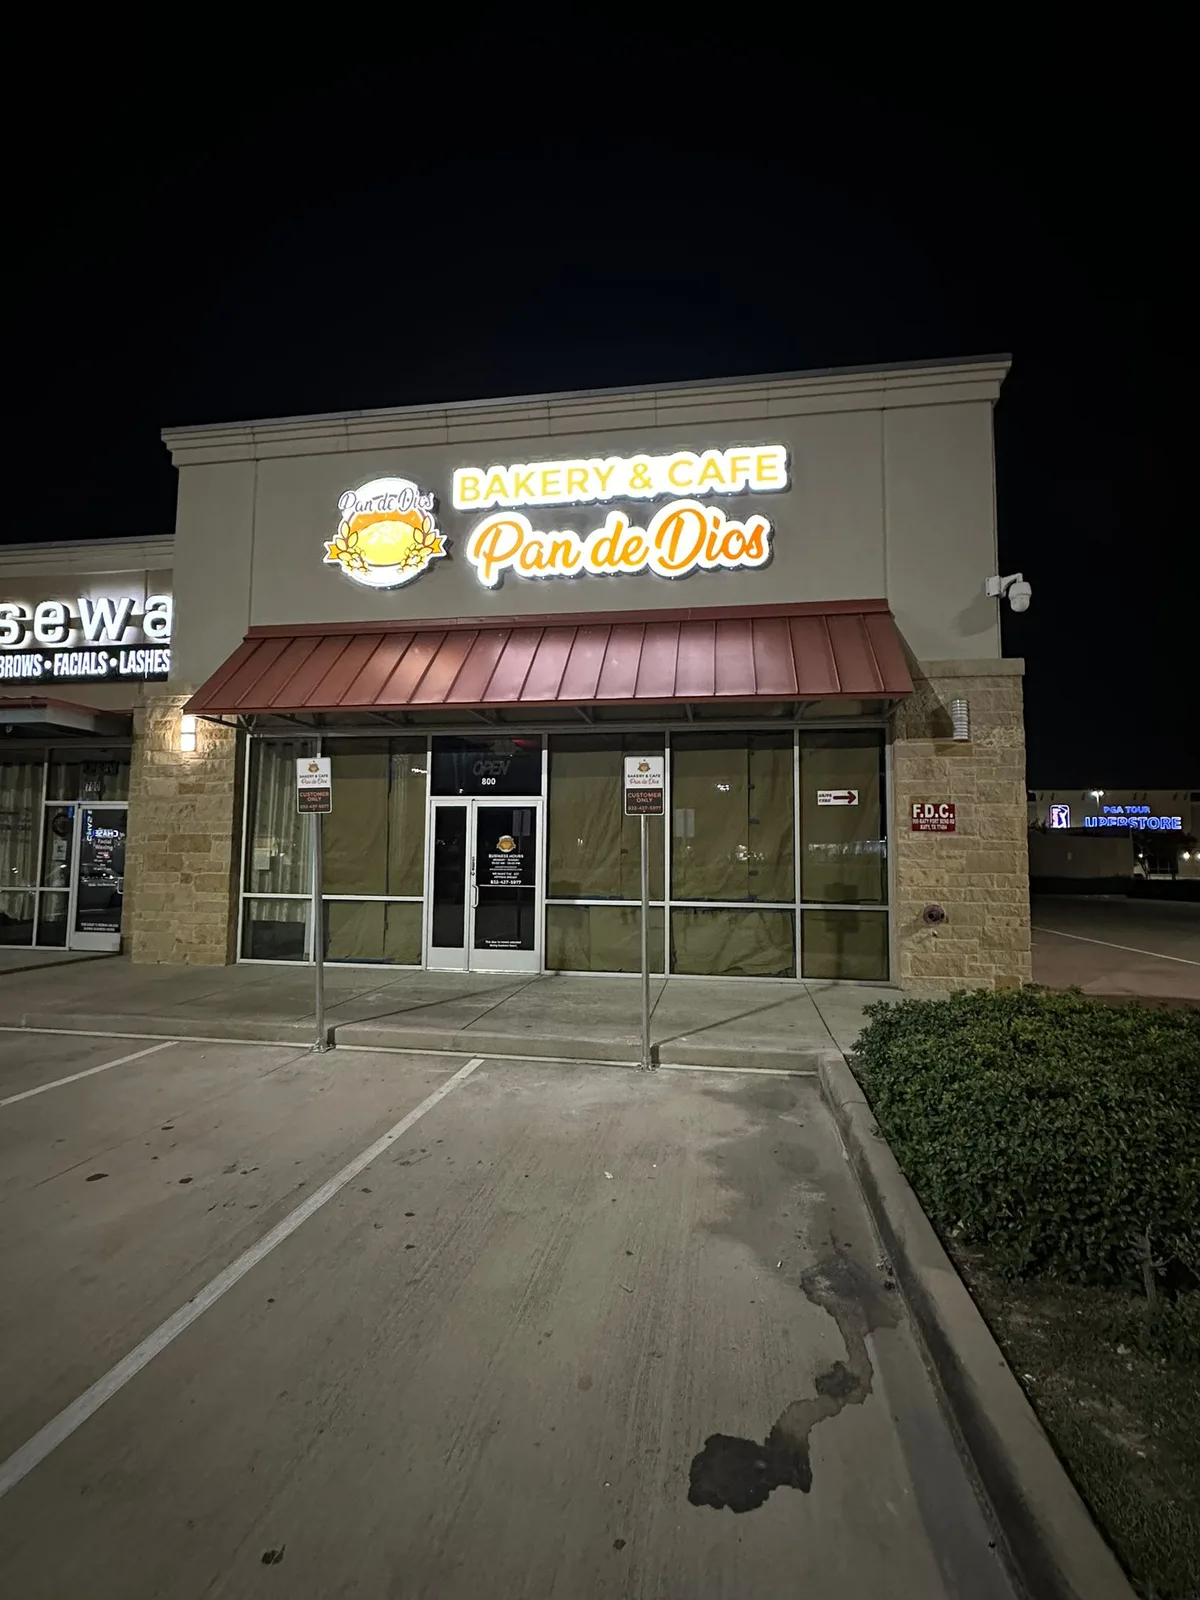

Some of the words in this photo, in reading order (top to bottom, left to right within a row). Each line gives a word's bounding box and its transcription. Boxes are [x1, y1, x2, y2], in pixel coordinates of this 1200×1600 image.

[459, 466, 616, 502] BAKERY
[627, 462, 653, 490] &
[668, 453, 780, 486] CAFE
[339, 491, 373, 513] Pan
[377, 493, 395, 511] de
[397, 487, 432, 512] Dios
[473, 521, 580, 580] Pan
[590, 520, 650, 566] de
[654, 507, 767, 572] Dios
[53, 650, 108, 677] FACIALS
[119, 648, 171, 675] LASHES
[472, 760, 511, 776] OPEN
[481, 777, 496, 786] 800
[912, 803, 954, 819] F.D.C.
[1104, 806, 1124, 814] PGA
[1125, 806, 1150, 814] TOUR
